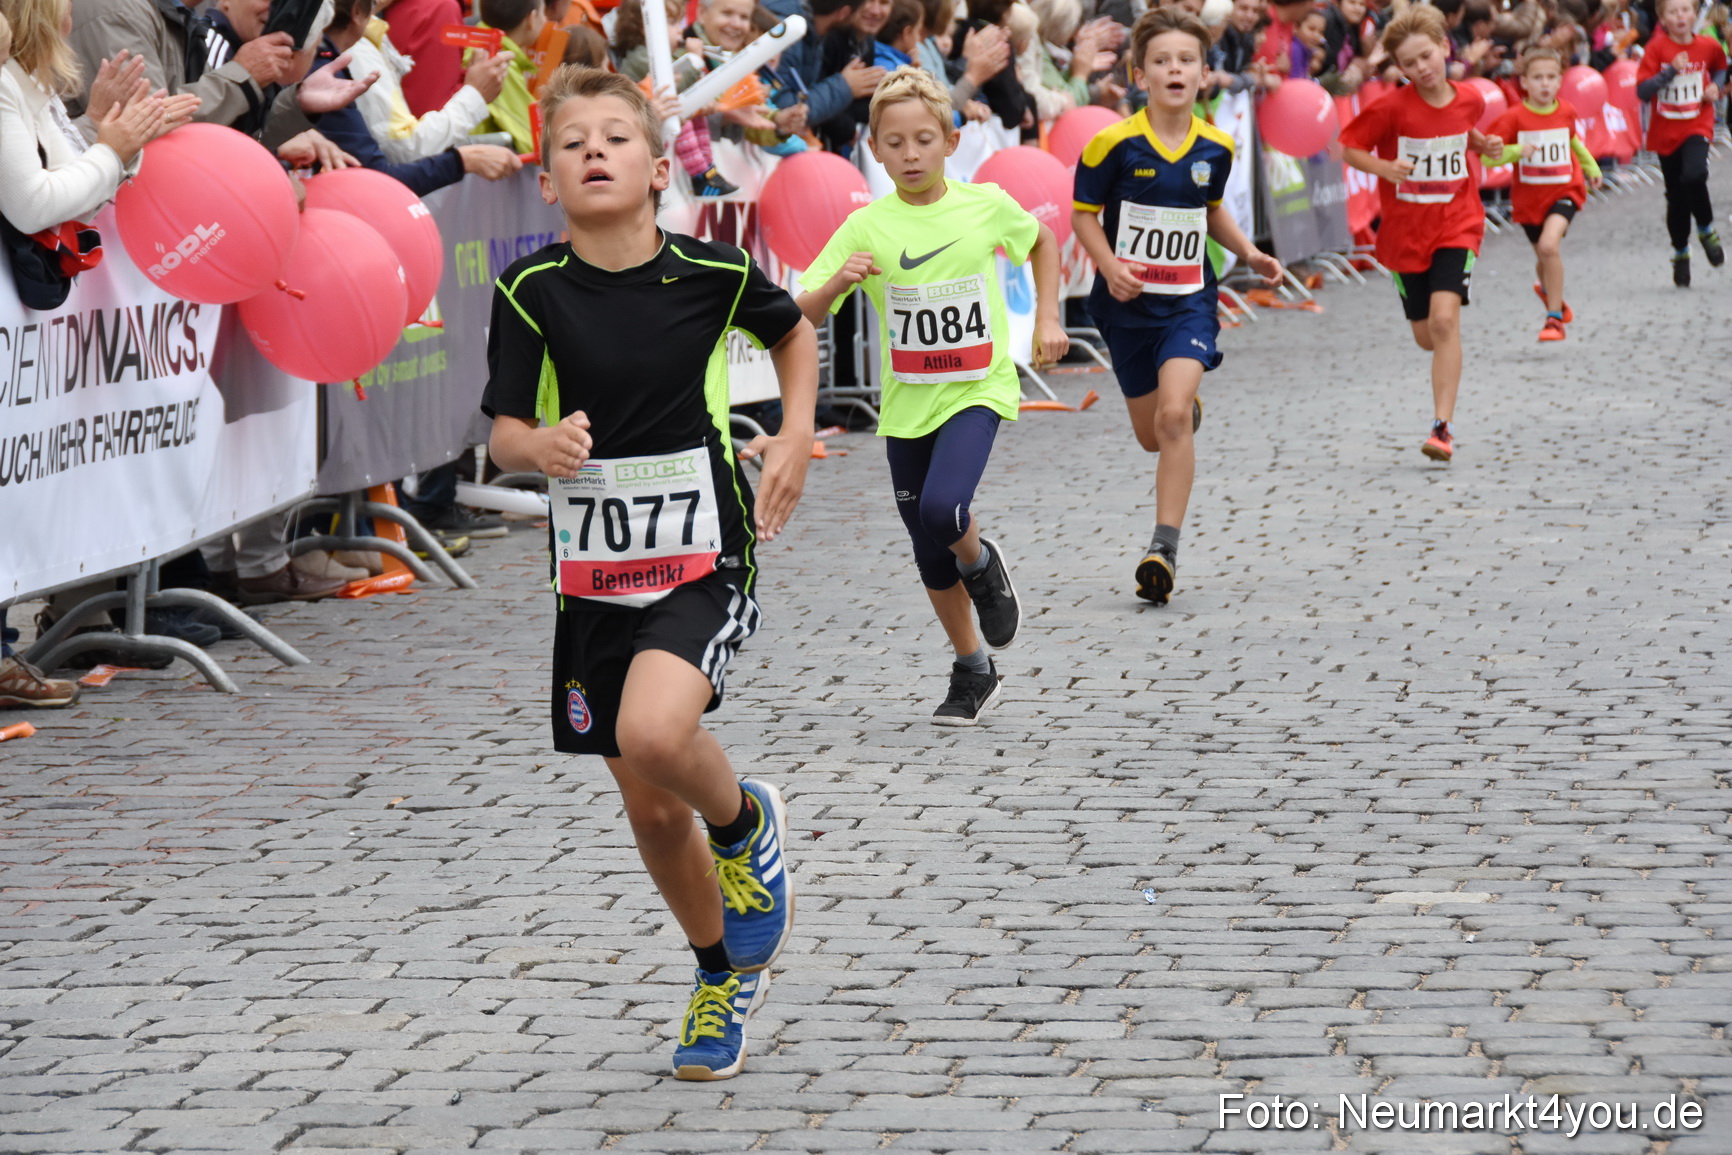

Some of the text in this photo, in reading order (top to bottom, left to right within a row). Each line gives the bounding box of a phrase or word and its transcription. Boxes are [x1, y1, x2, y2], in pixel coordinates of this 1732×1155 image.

[1406, 151, 1461, 177] 7116
[189, 228, 226, 265] energie
[1128, 224, 1200, 261] 7000
[927, 279, 980, 299] BOCK
[893, 300, 986, 346] 7084
[923, 355, 962, 370] Attila
[46, 418, 86, 476] MEHR
[558, 476, 606, 486] NeuerMarkt
[615, 456, 697, 482] BOCK
[567, 489, 701, 553] 7077
[563, 549, 569, 558] 6
[709, 540, 716, 549] K
[592, 564, 685, 590] Benedikt
